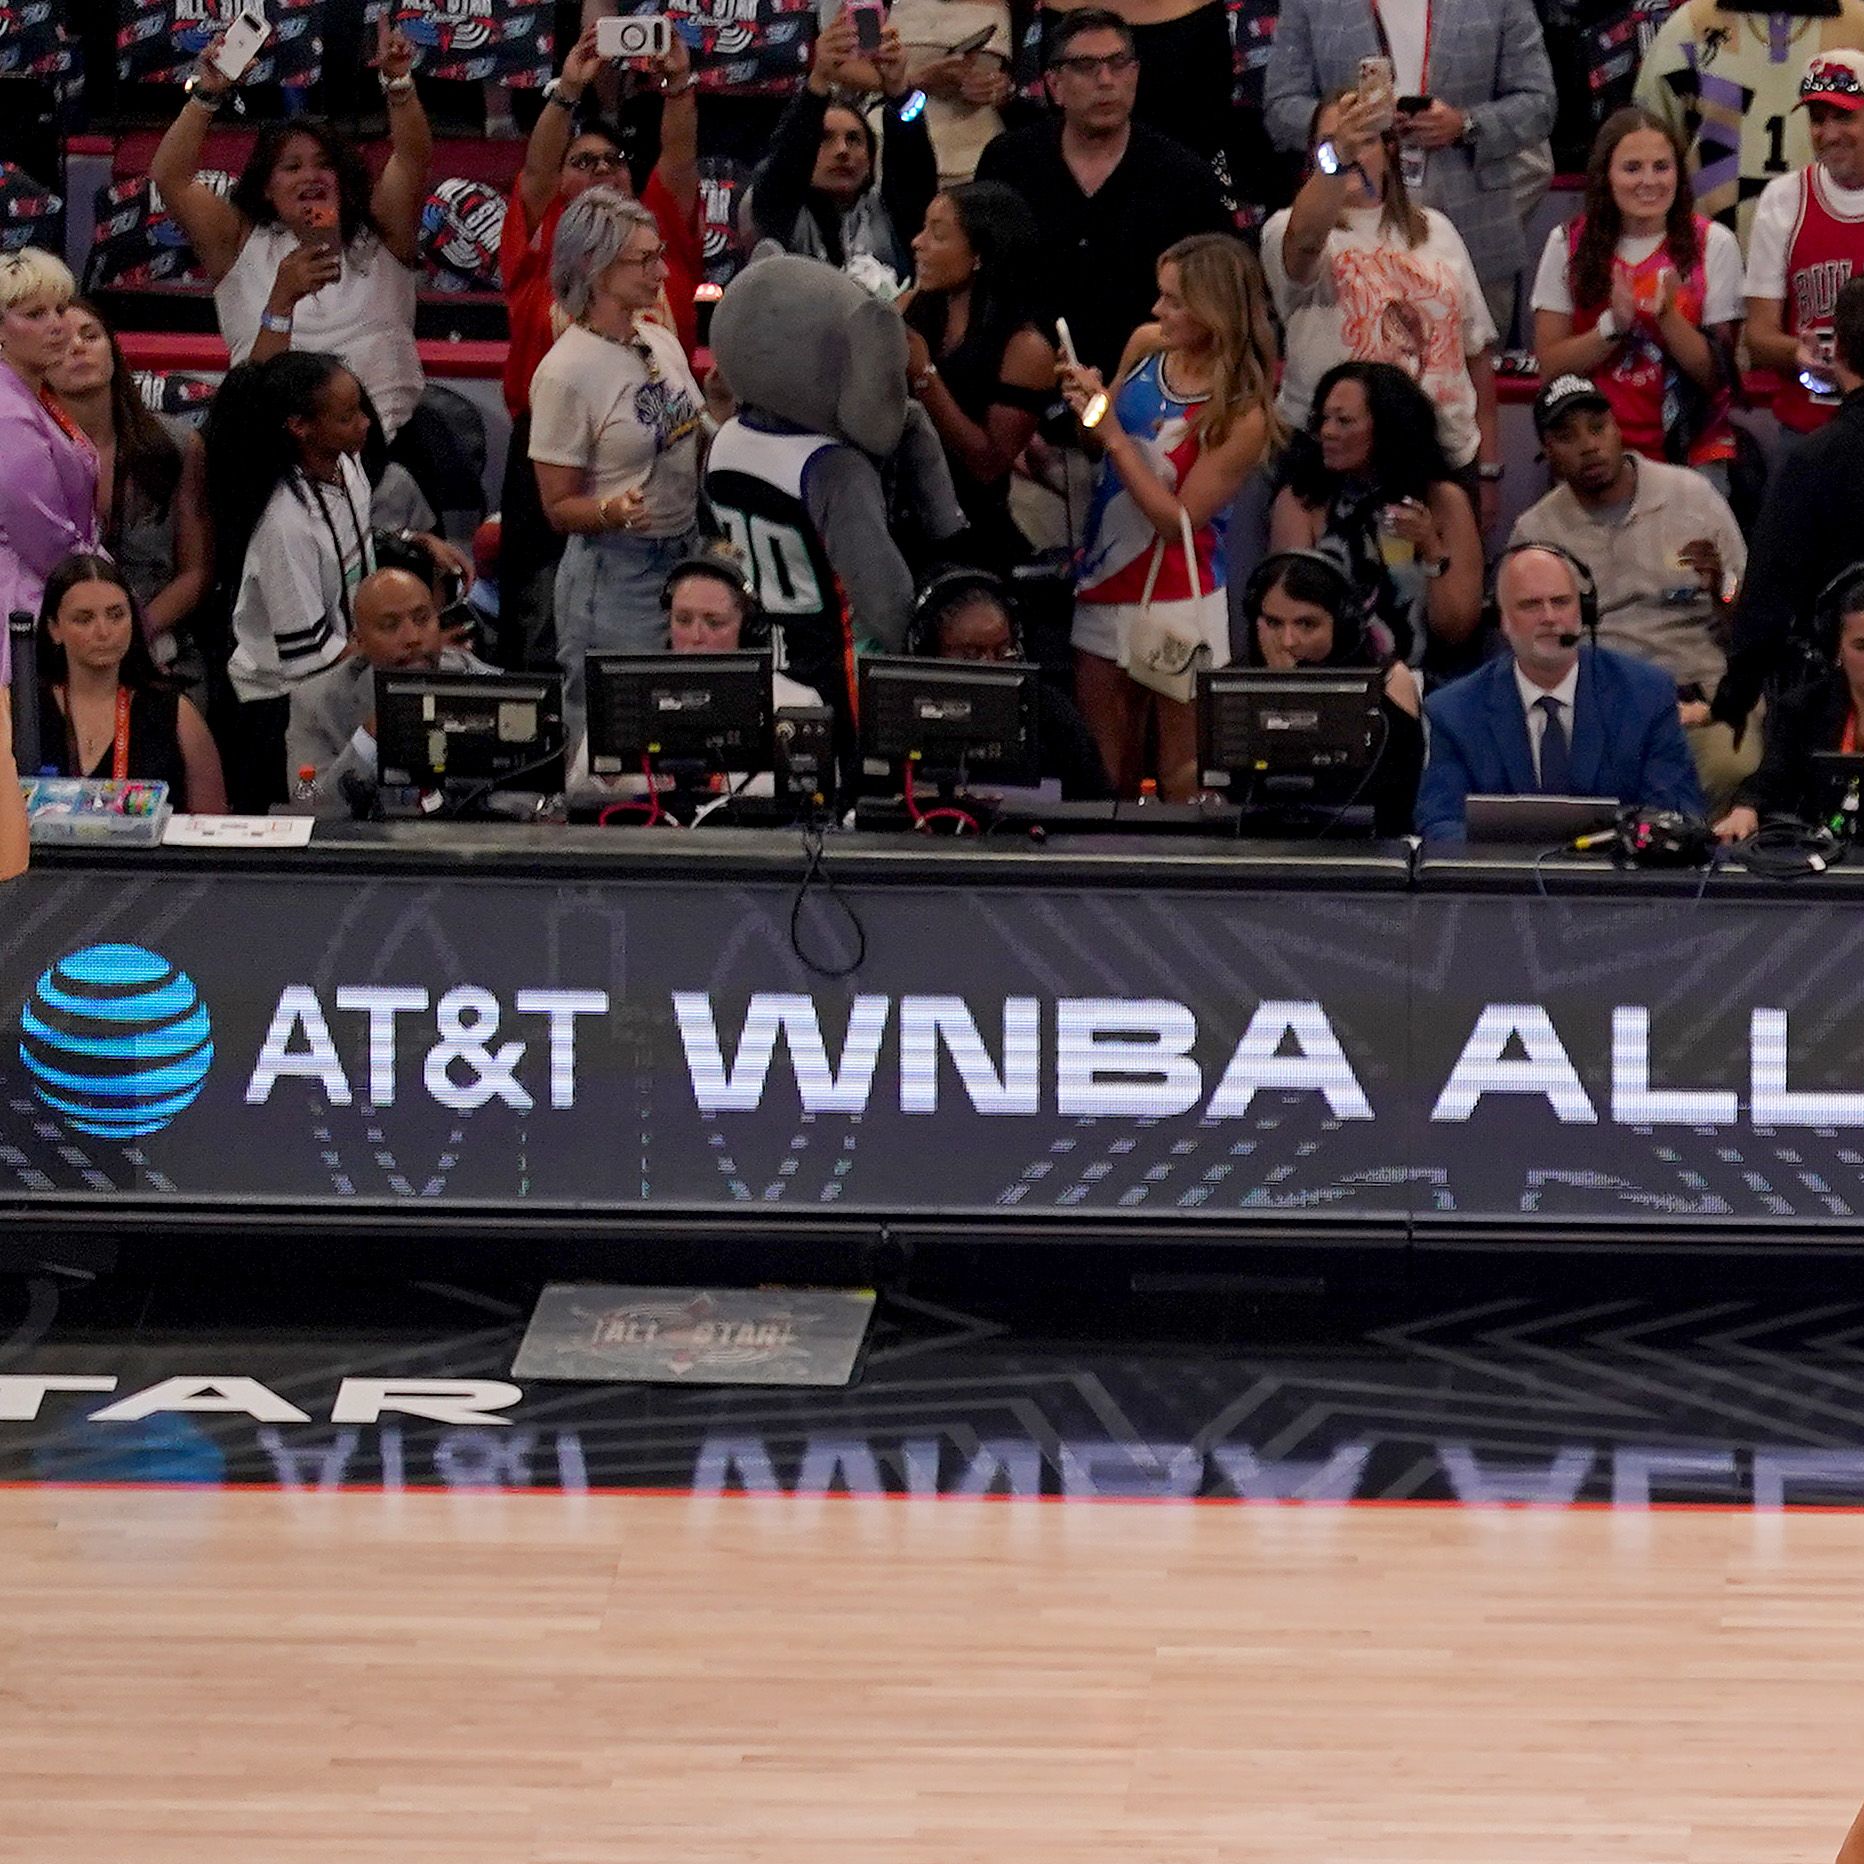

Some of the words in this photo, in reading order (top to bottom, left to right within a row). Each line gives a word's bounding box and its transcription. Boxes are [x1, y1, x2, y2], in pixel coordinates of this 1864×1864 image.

[1765, 116, 1788, 172] 1
[244, 985, 609, 1113] AT&T
[671, 990, 1375, 1121] WNBA
